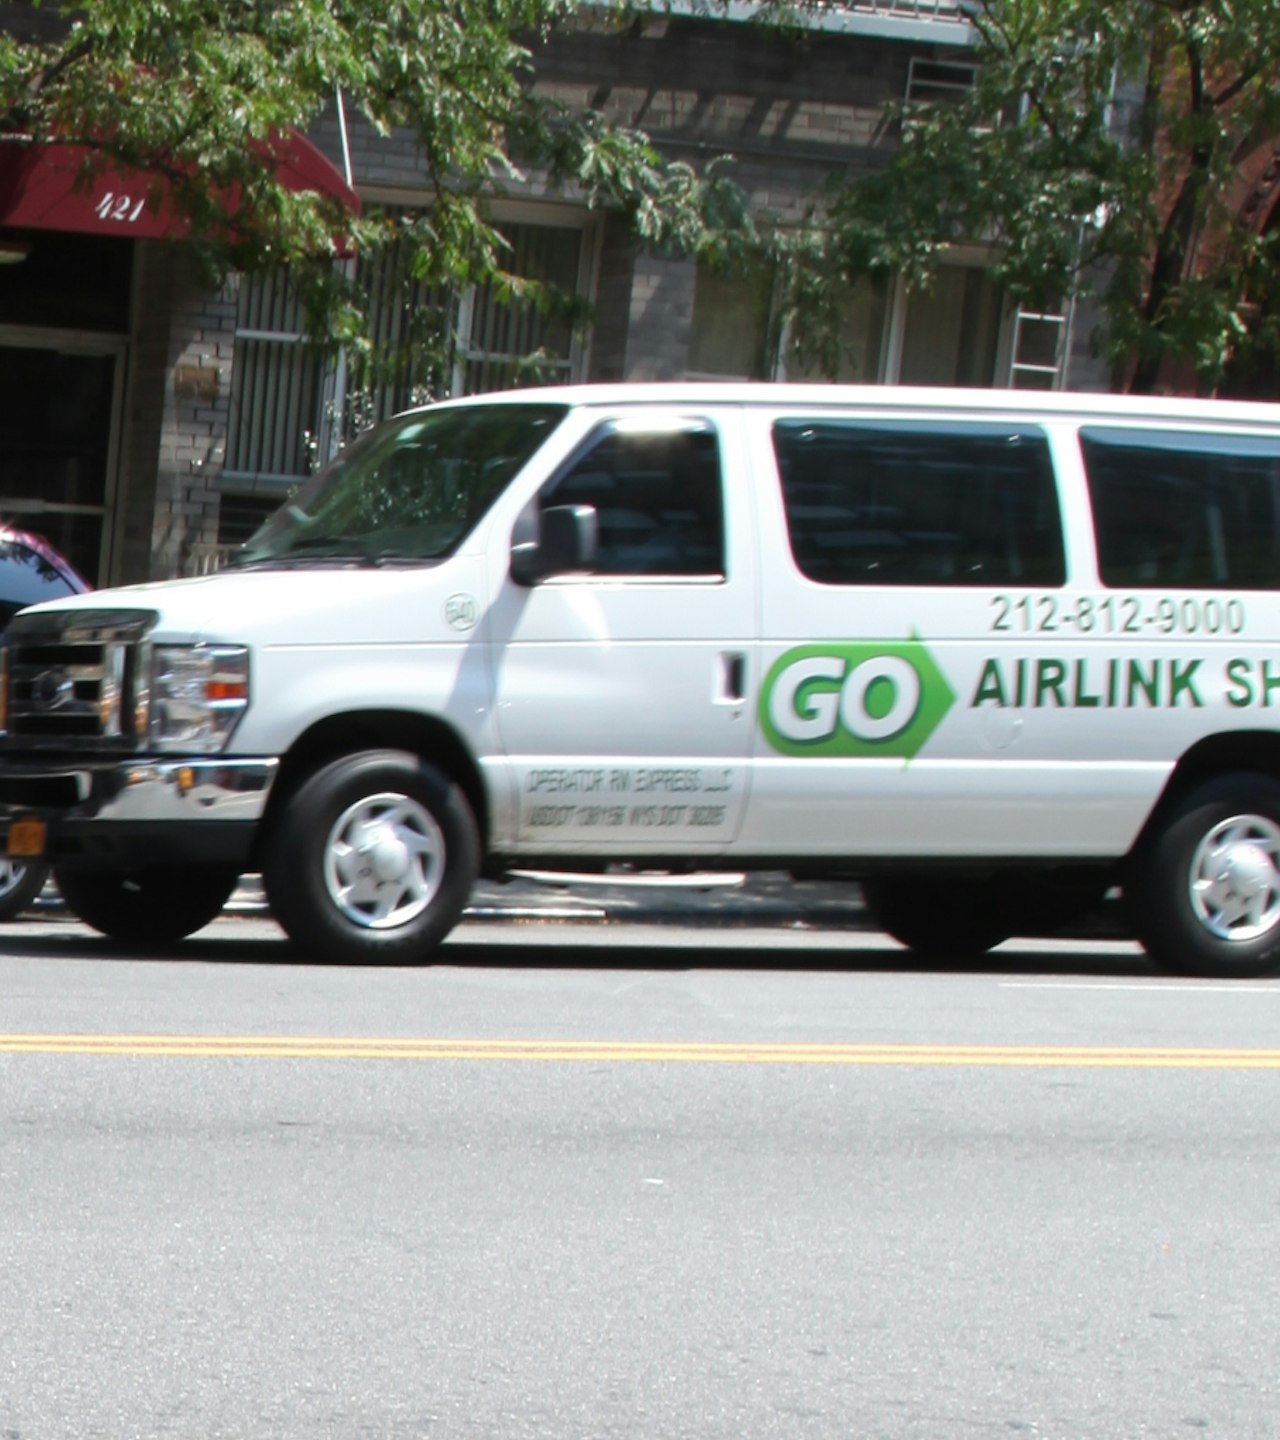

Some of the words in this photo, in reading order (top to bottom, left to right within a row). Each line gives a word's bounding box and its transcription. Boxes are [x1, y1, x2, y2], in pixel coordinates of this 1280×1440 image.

[94, 191, 145, 224] 421
[989, 595, 1246, 634] 212-812-9000
[767, 654, 921, 744] GO
[968, 658, 1206, 708] AIRLINK
